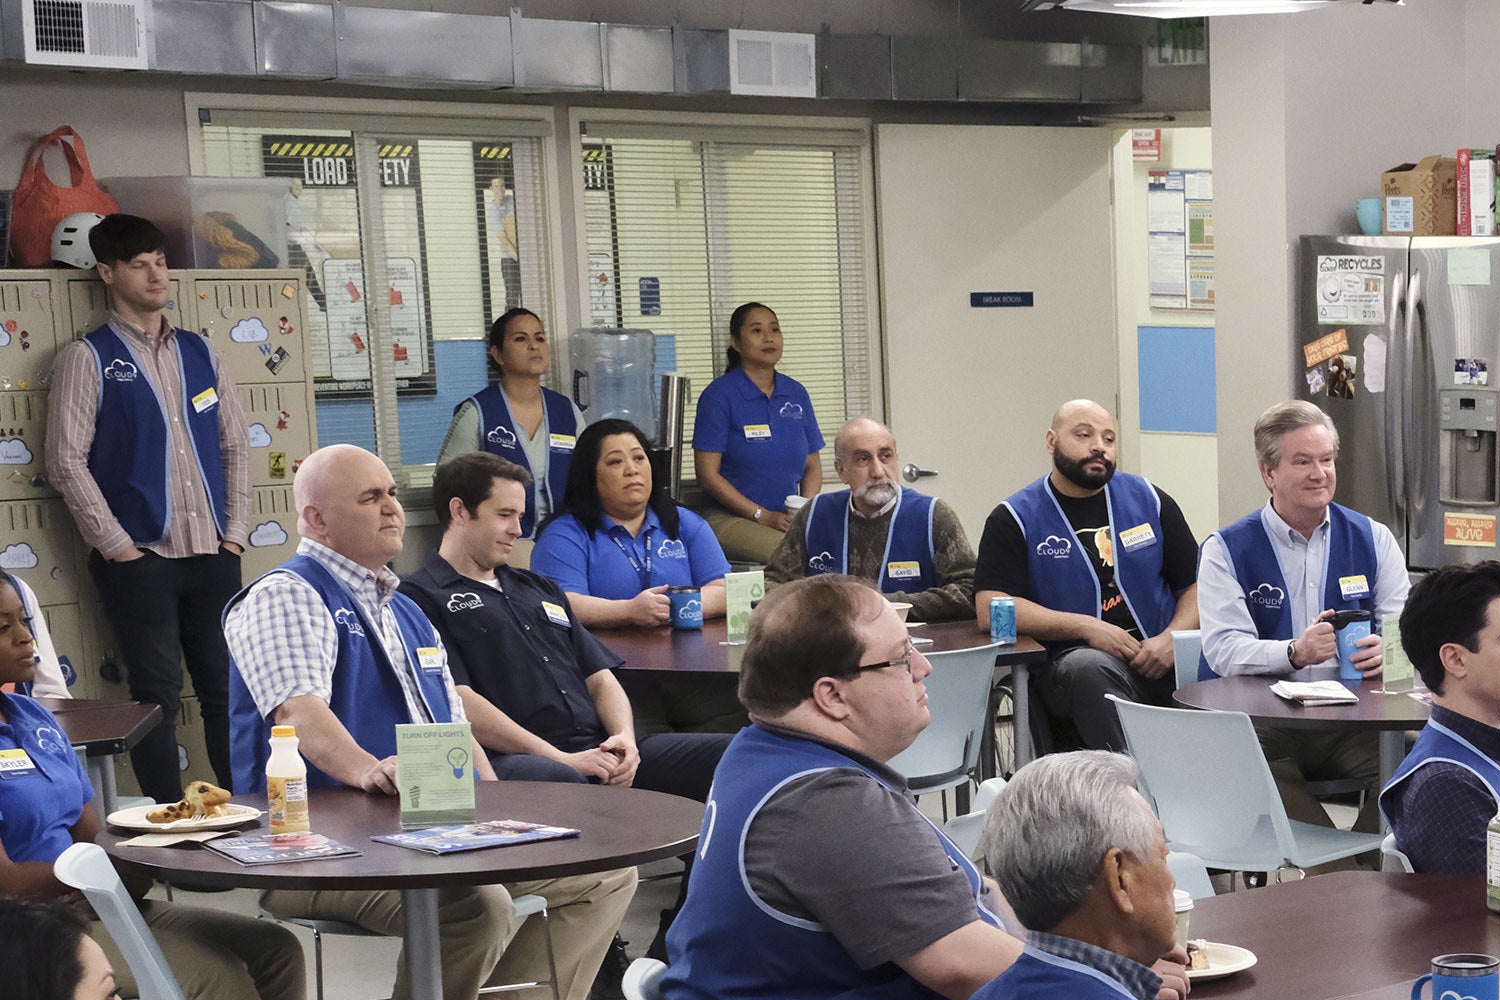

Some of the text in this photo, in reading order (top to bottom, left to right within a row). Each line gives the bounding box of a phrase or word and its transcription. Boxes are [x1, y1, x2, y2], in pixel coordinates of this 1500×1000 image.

[303, 158, 348, 185] LOAD
[1338, 259, 1382, 270] RECYCLES
[1124, 531, 1153, 546] GARRETT
